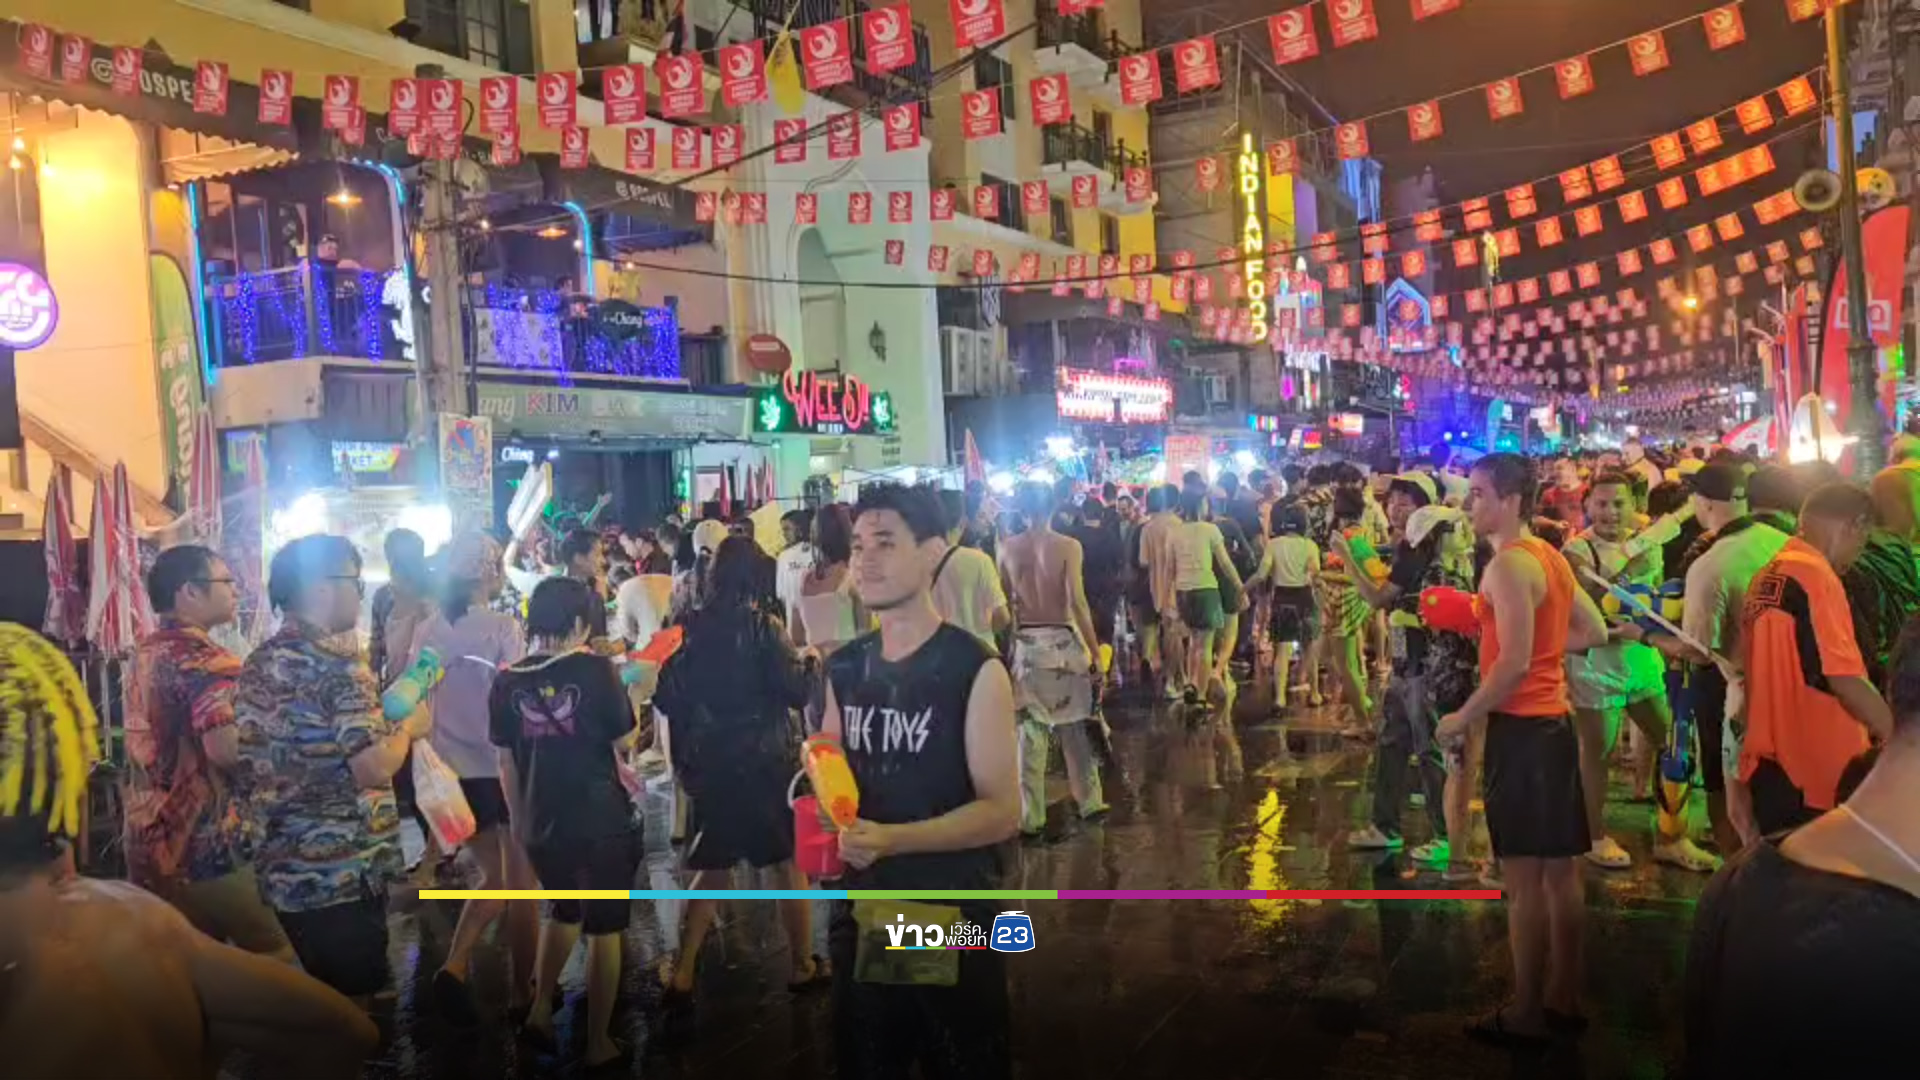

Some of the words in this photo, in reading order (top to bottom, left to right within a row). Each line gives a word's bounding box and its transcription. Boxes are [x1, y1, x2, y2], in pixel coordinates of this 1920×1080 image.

[1239, 133, 1263, 254] INDIAN
[1246, 260, 1268, 340] FOOD
[527, 392, 578, 417] KIM
[844, 705, 875, 755] THE
[880, 705, 933, 753] TOYS
